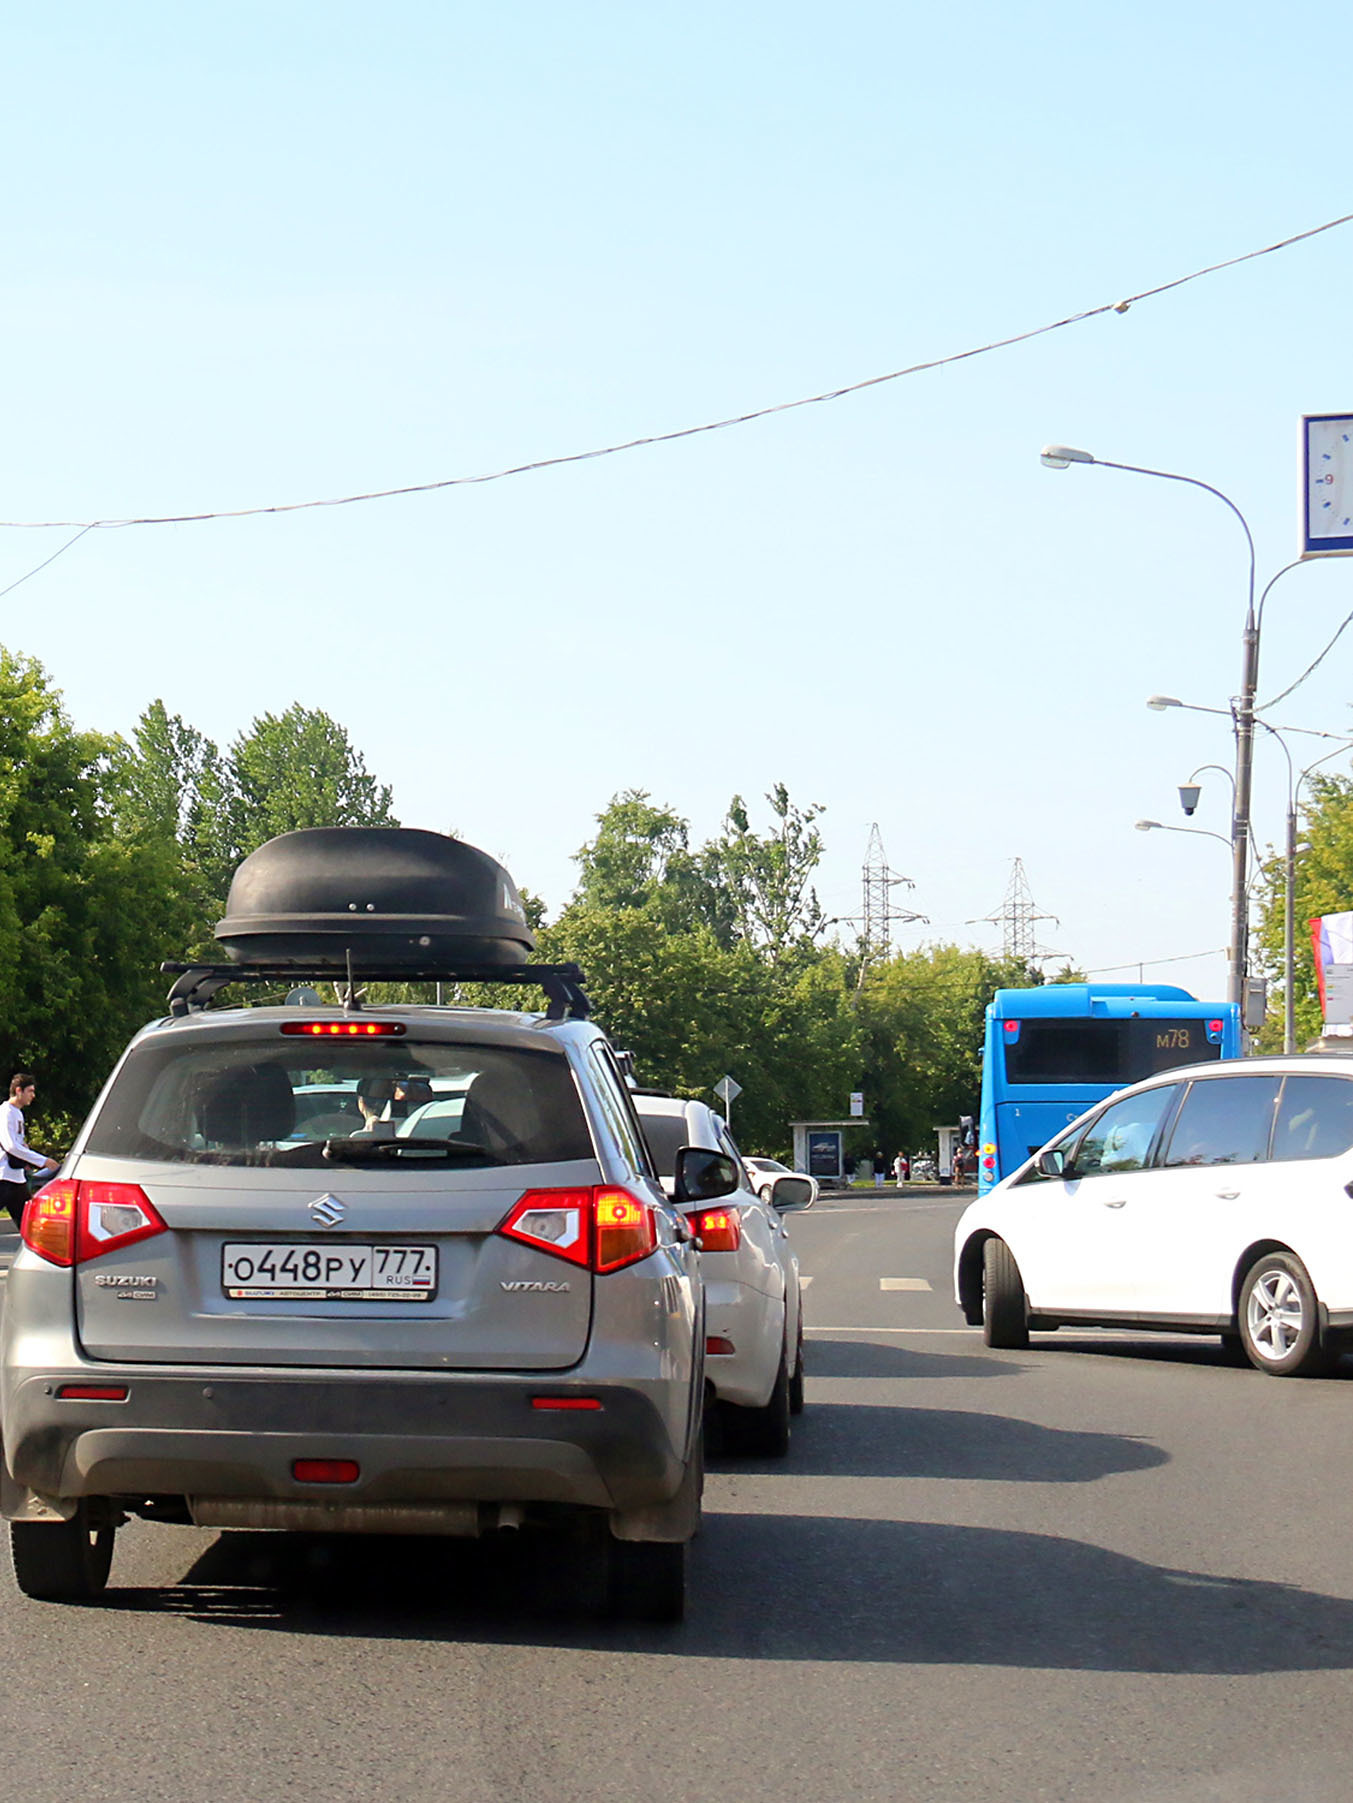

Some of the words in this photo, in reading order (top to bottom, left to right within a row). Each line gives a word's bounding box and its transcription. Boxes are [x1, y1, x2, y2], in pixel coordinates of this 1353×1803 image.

[1324, 474, 1334, 485] 9
[375, 1248, 426, 1274] 777
[95, 1275, 157, 1287] SUZUKI
[386, 1275, 411, 1285] RUS
[500, 1281, 571, 1293] VITARA
